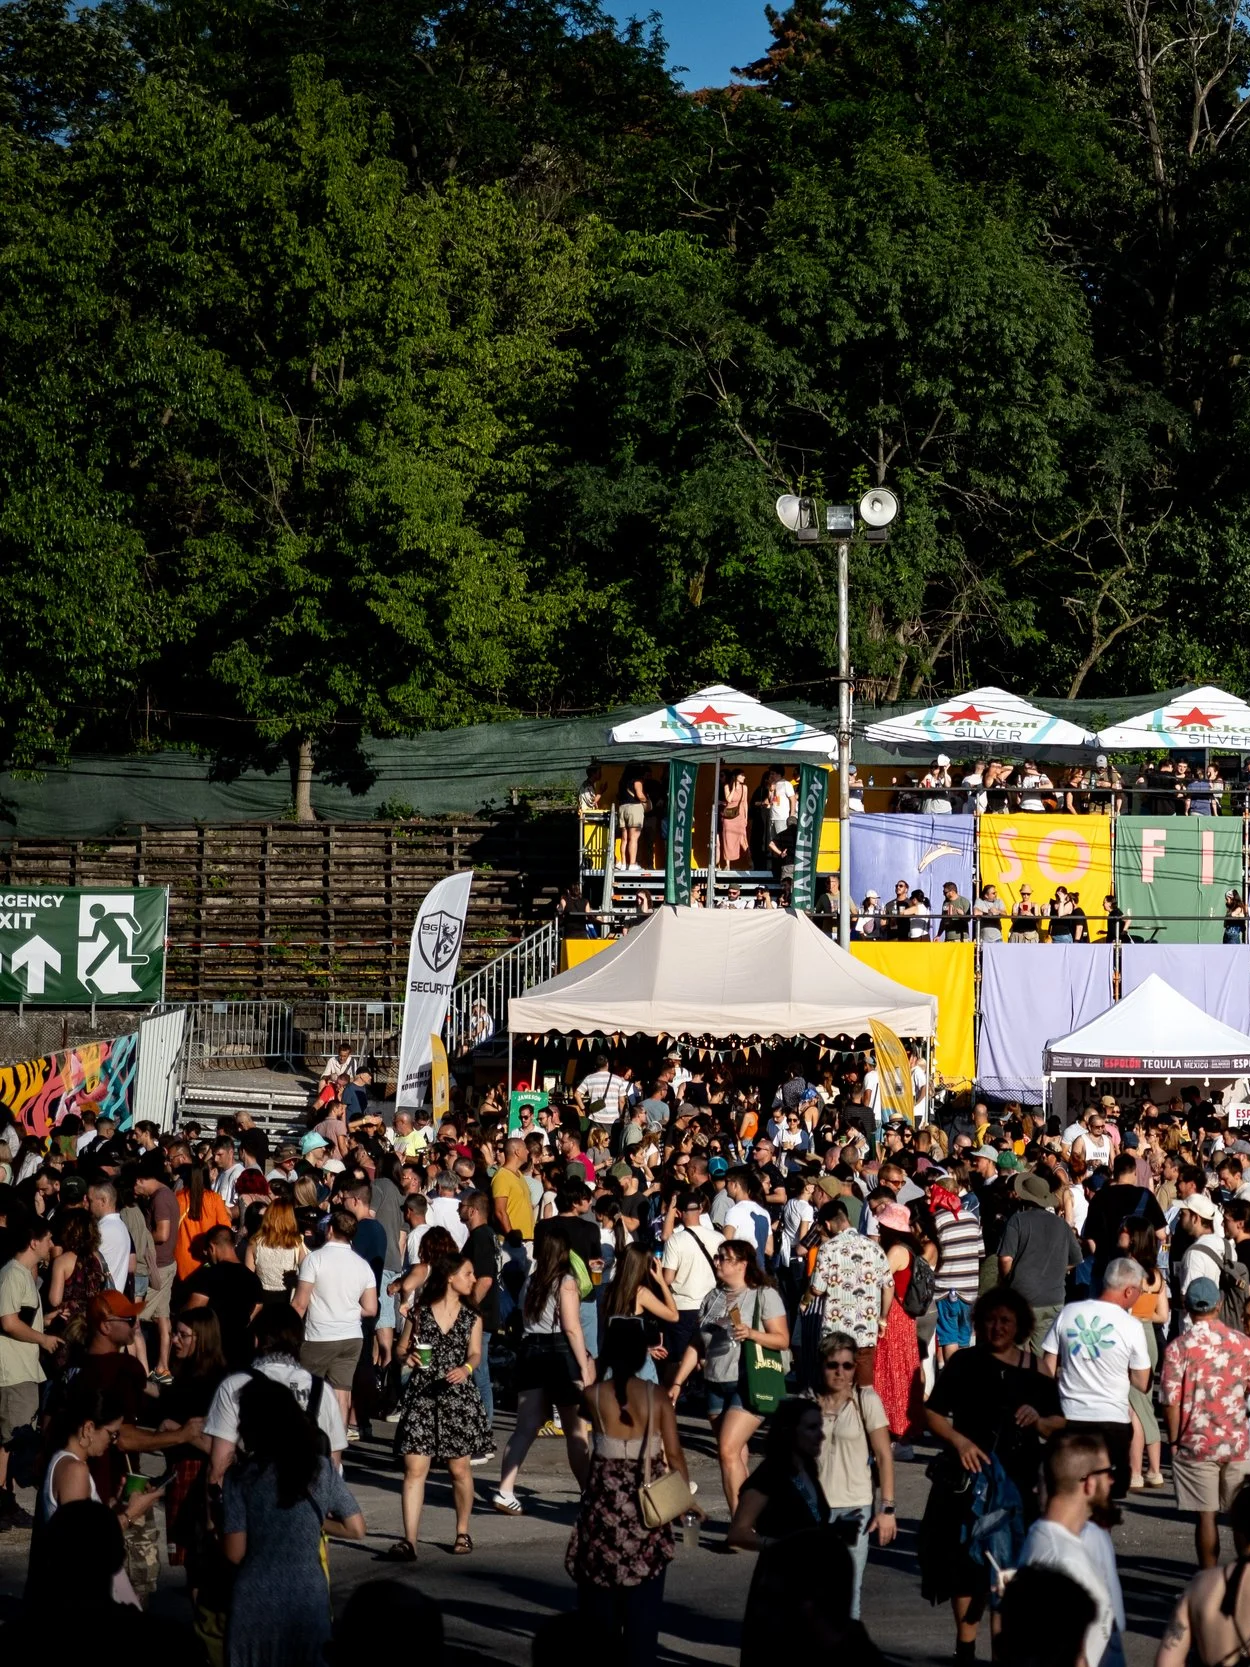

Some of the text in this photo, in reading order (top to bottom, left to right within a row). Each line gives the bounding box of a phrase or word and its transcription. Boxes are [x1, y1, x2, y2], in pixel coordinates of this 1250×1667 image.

[914, 719, 1037, 729] Heineken
[704, 731, 773, 746] SILVER
[955, 728, 1022, 741] SILVER
[674, 769, 693, 900] JAMESON
[794, 776, 823, 904] JAMESON
[422, 923, 438, 931] BG
[1142, 1059, 1182, 1069] TEQUILA
